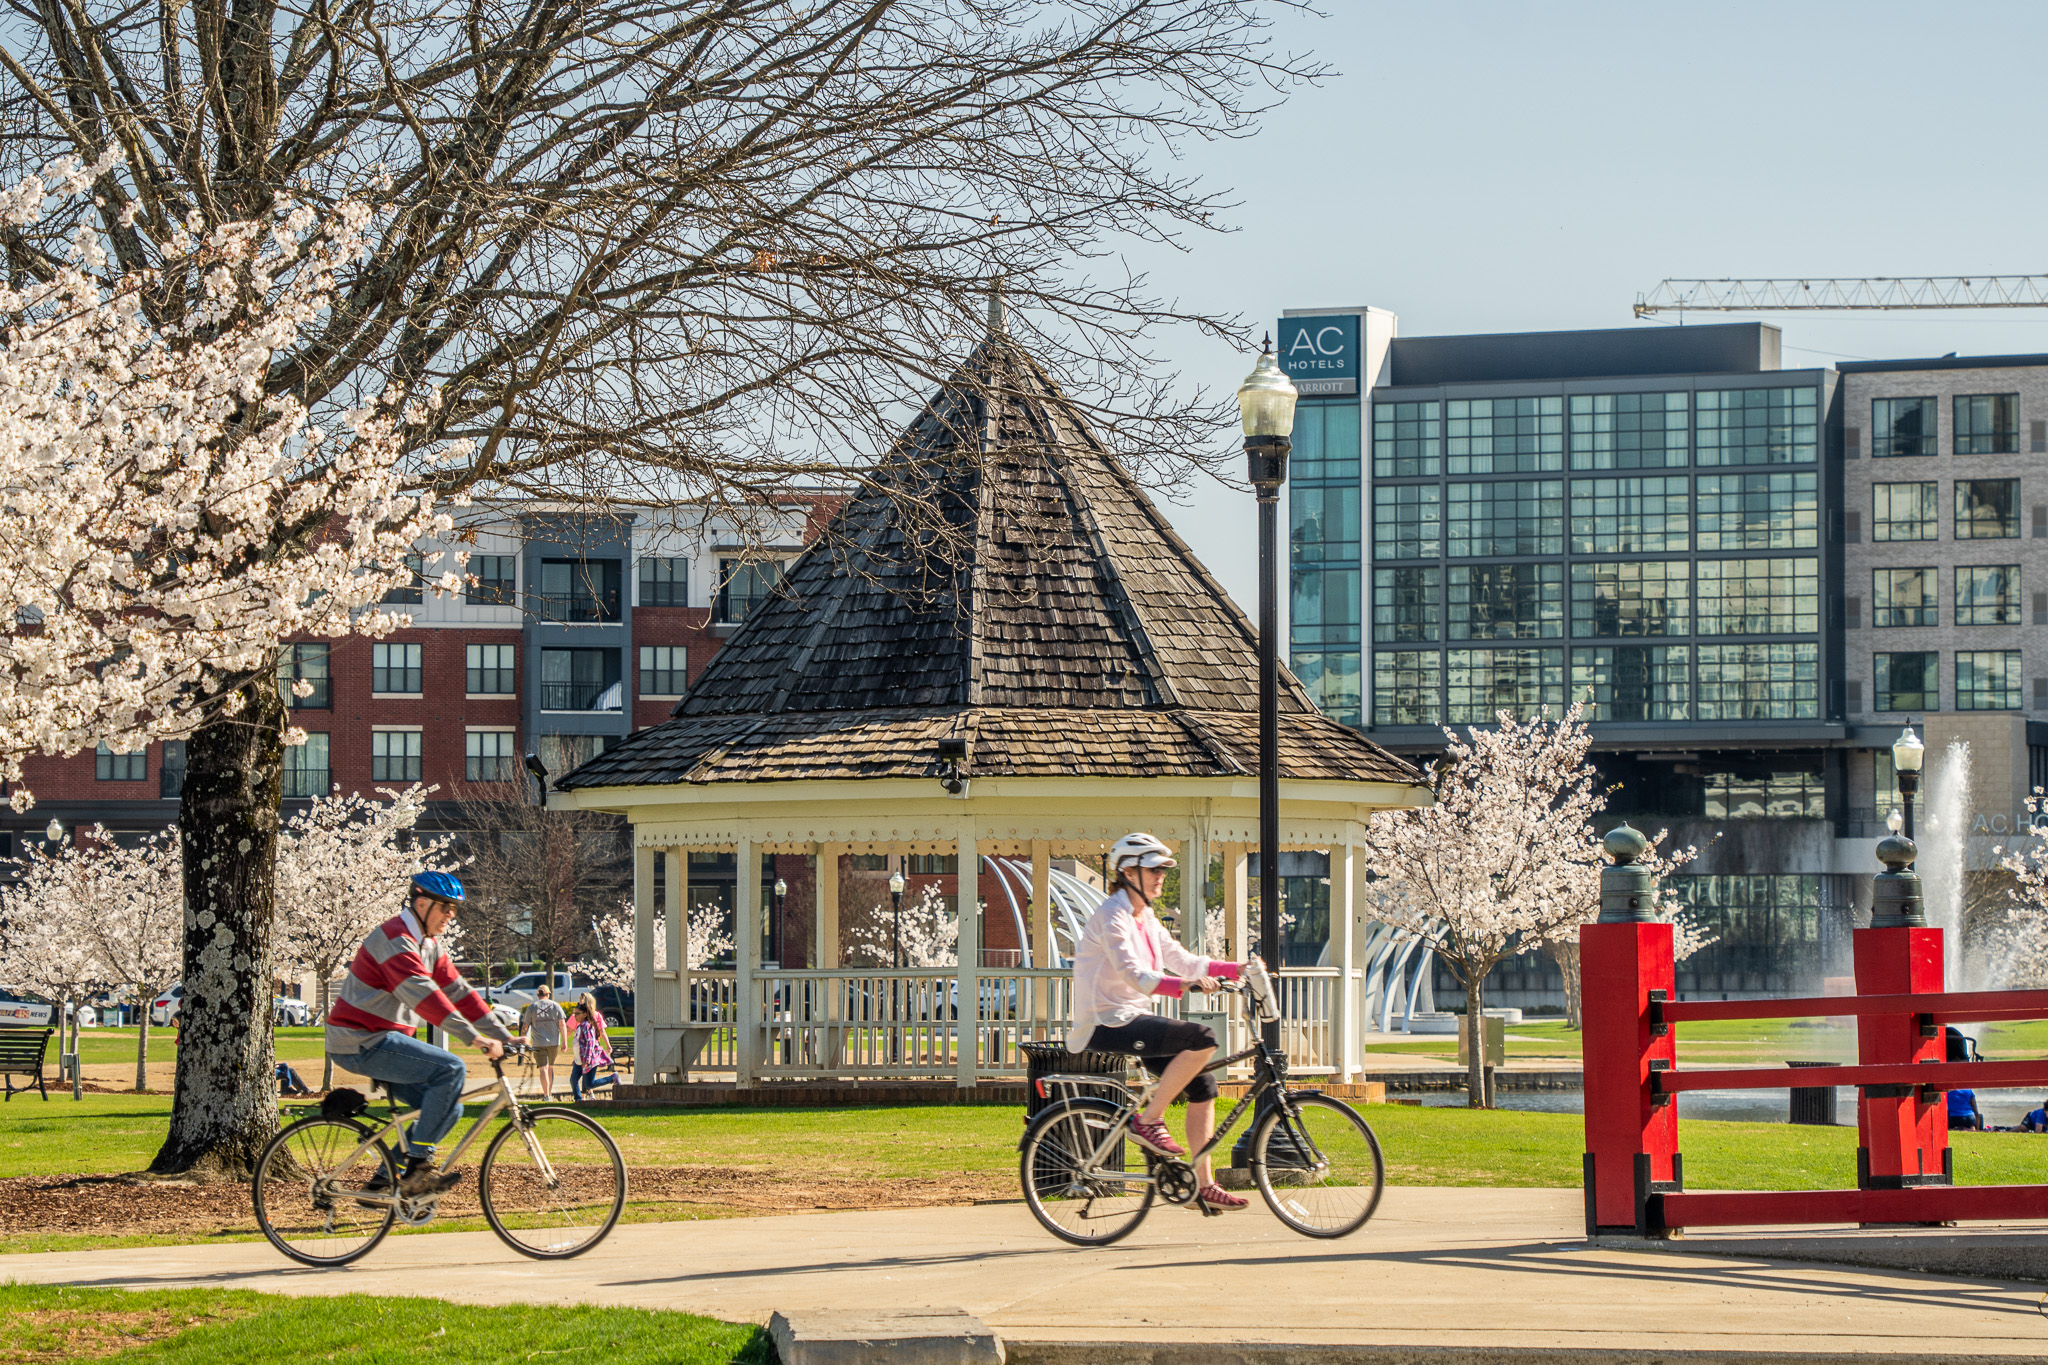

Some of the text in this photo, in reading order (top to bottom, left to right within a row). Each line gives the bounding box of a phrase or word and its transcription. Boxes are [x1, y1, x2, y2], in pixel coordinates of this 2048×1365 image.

[1289, 326, 1344, 356] AC
[1288, 359, 1345, 370] HOTELS
[1296, 382, 1344, 393] ARRIOTT
[1973, 813, 2007, 833] AC
